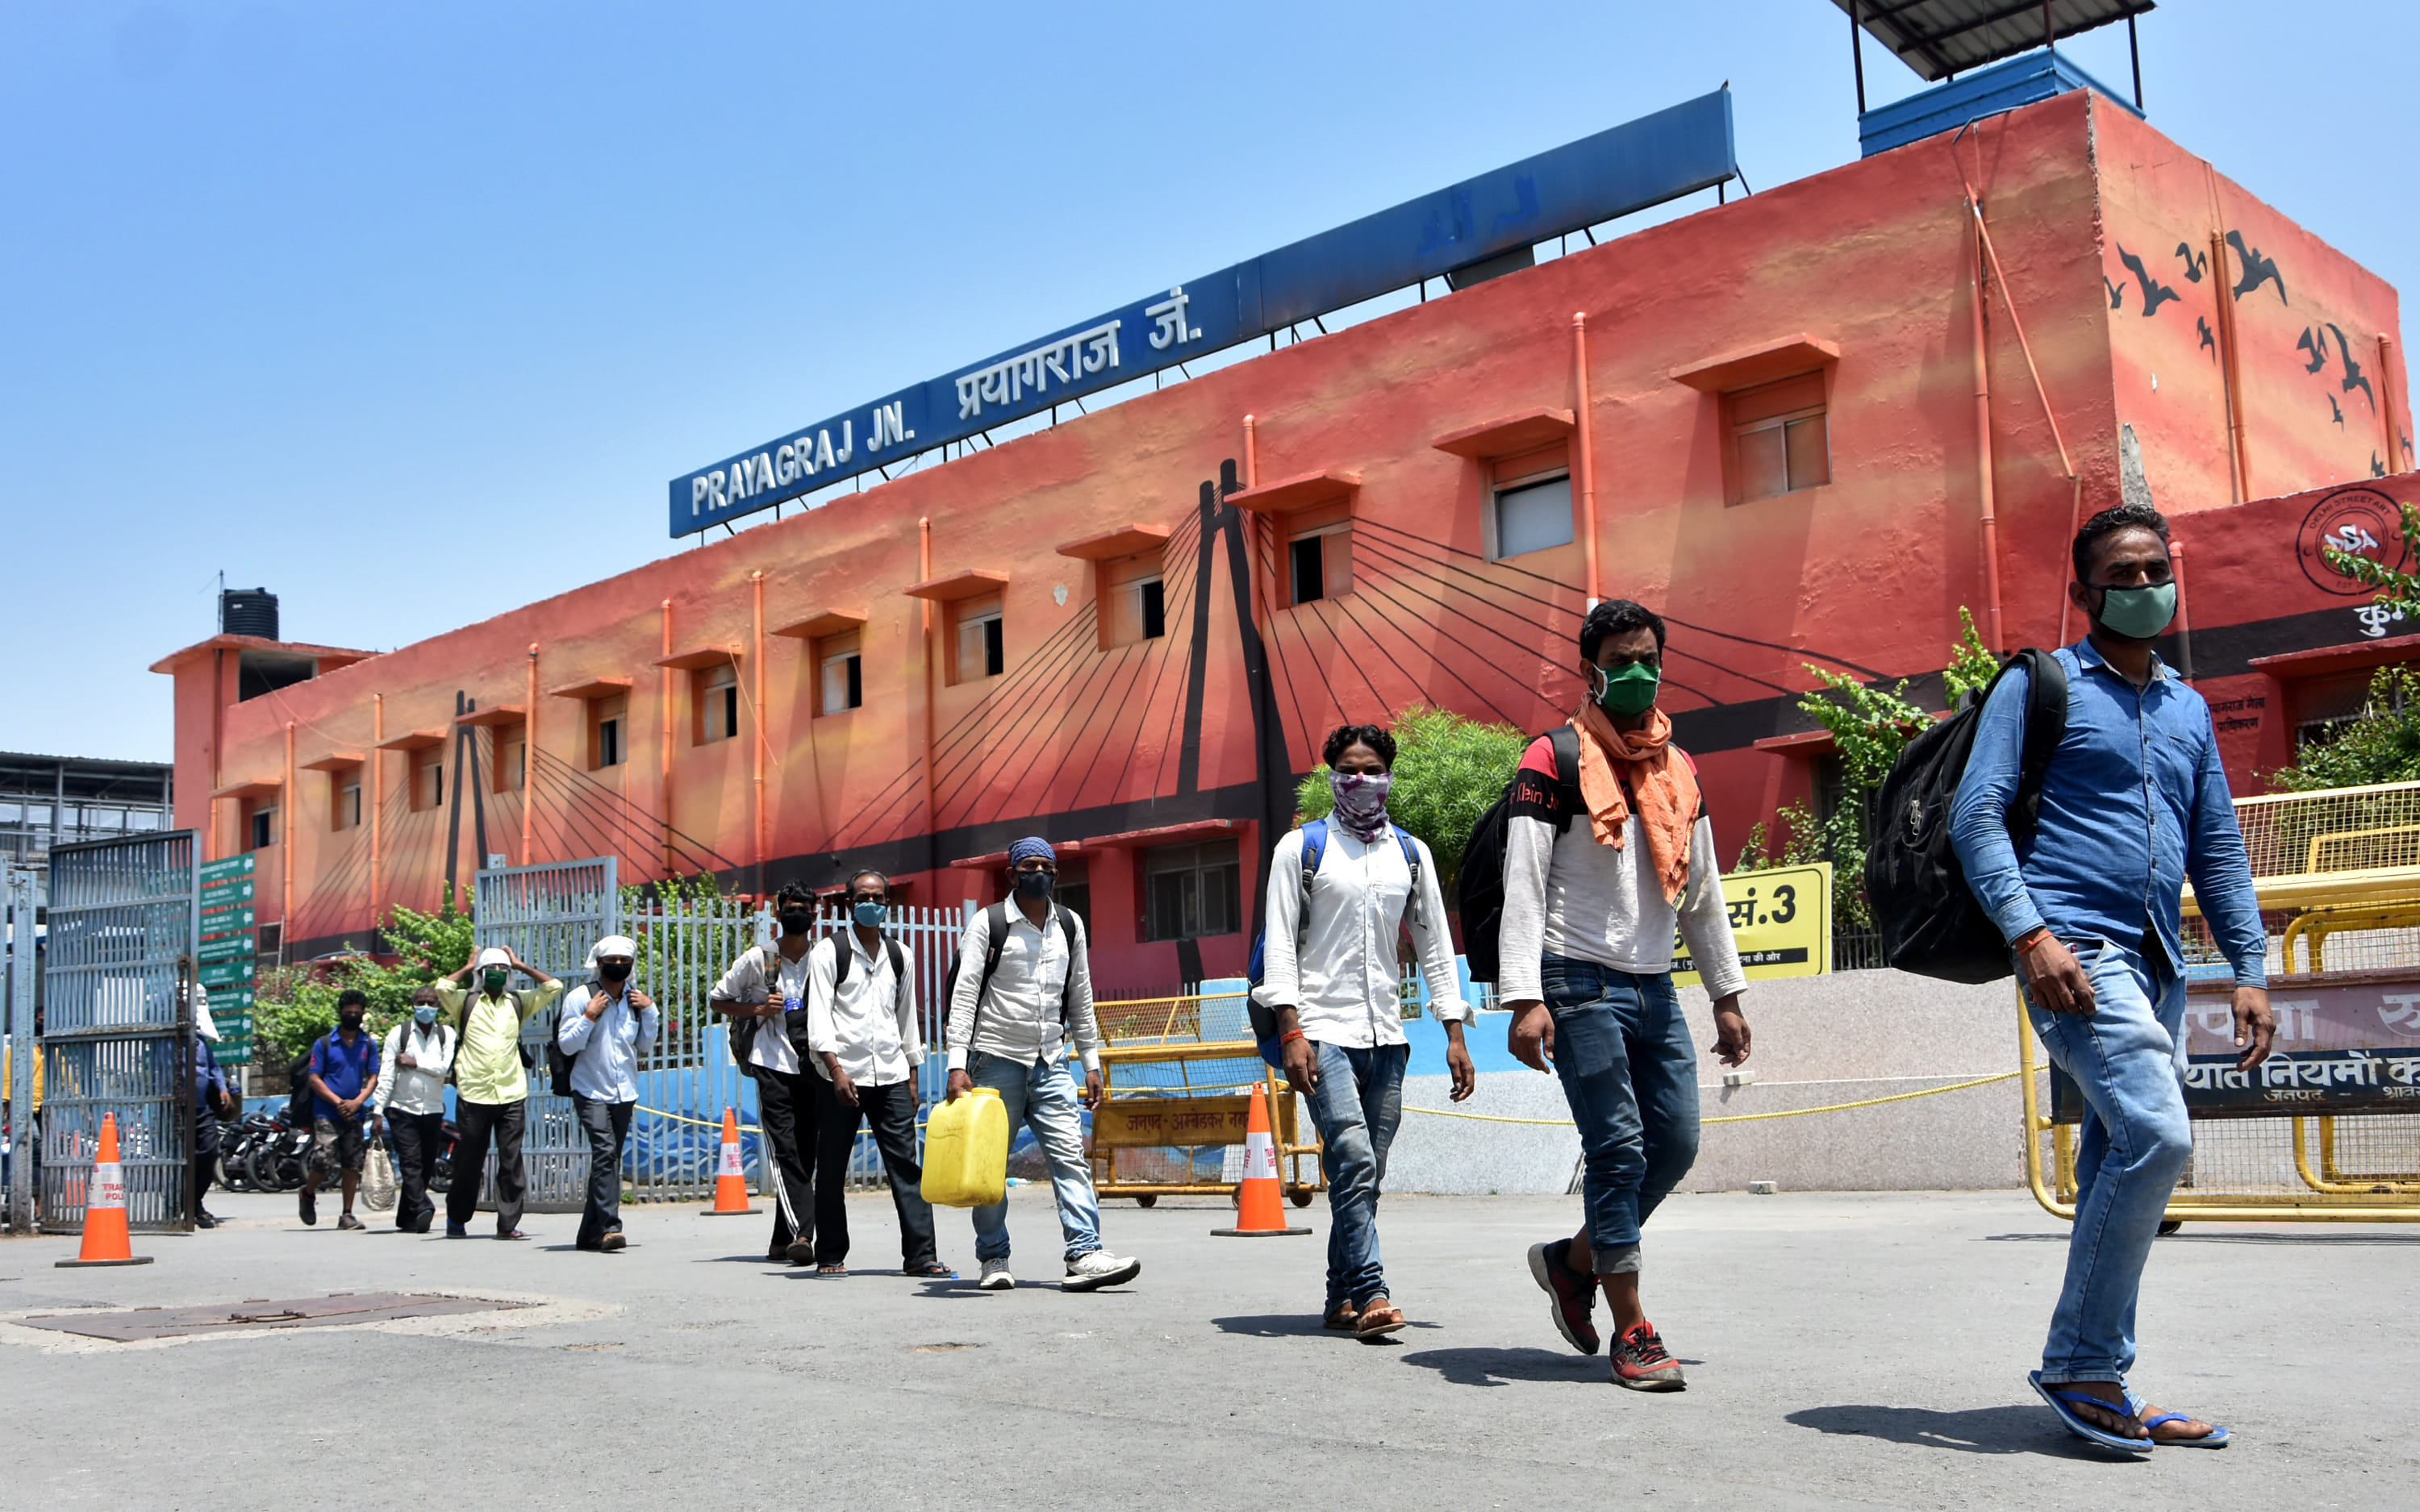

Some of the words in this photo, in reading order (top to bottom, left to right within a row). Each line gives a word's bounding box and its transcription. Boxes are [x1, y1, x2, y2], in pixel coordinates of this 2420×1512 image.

[955, 319, 1121, 420] प्रयागराज
[1145, 285, 1202, 350] जं.
[692, 419, 852, 516] PRAYAGRAJ
[866, 401, 915, 452] JN.
[2309, 504, 2334, 529] DELHI
[2334, 495, 2372, 506] STREET
[2373, 500, 2392, 515] ART
[1517, 782, 1543, 805] Klein
[2259, 1050, 2383, 1088] नियमों
[2264, 1089, 2326, 1102] जनपद
